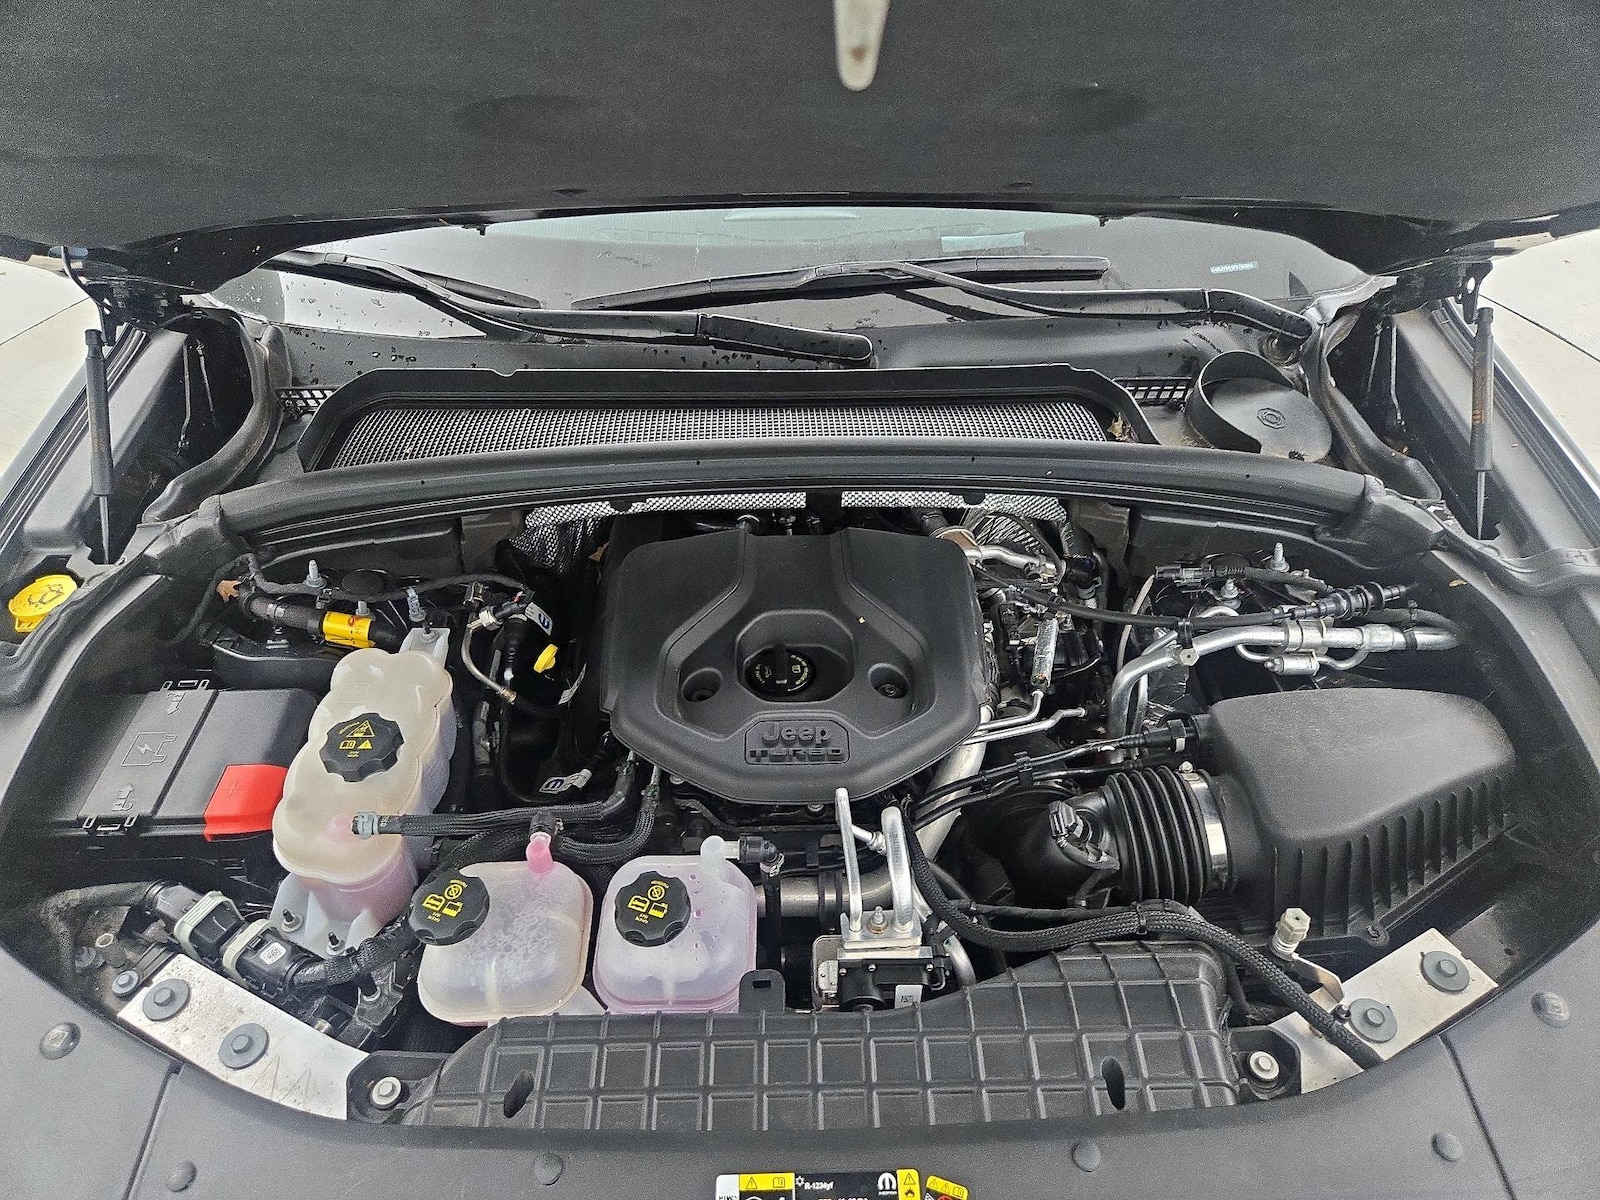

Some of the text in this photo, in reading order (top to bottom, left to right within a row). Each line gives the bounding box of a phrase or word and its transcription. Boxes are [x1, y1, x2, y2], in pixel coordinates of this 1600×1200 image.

[761, 721, 832, 746] Jeep
[748, 747, 845, 762] TURBO
[804, 1181, 834, 1191] R-1234yf
